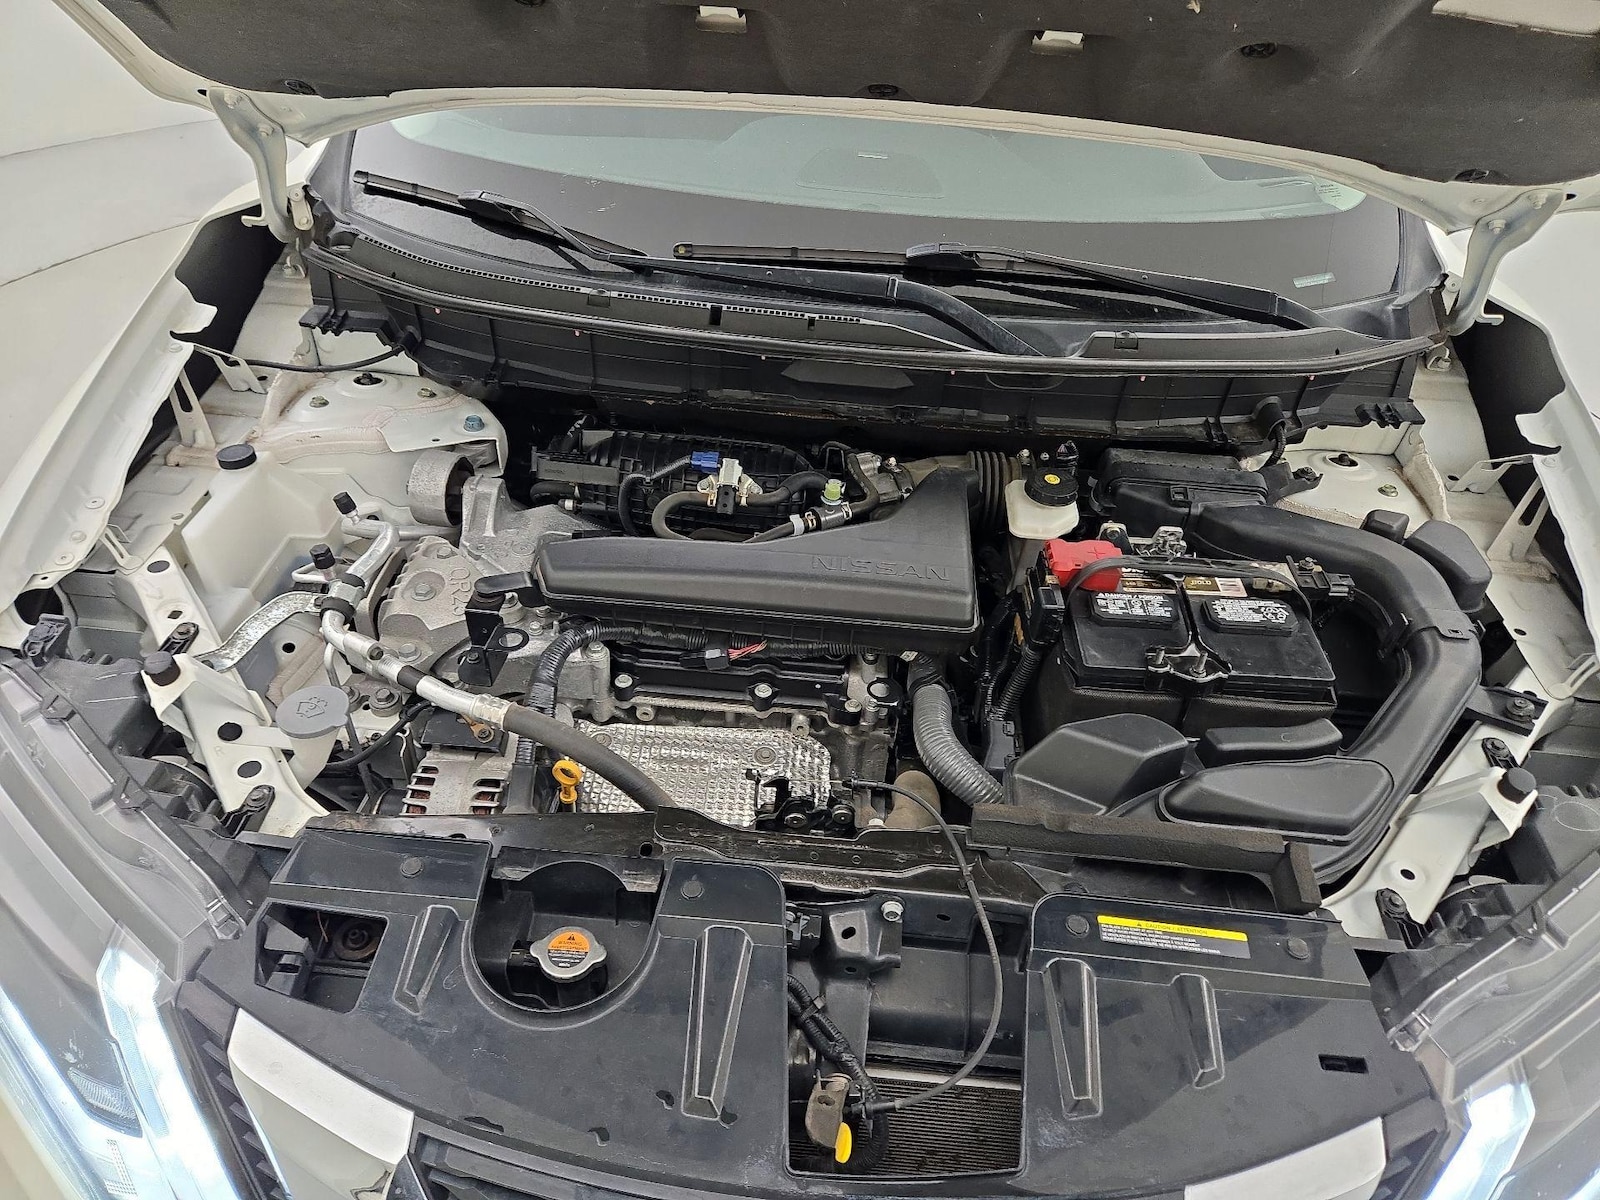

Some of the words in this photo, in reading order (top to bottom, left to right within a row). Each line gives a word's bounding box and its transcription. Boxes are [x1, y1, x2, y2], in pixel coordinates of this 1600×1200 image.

[811, 555, 950, 581] NISSAN
[1145, 922, 1171, 930] CAUTION
[1177, 926, 1208, 935] ATTENTION
